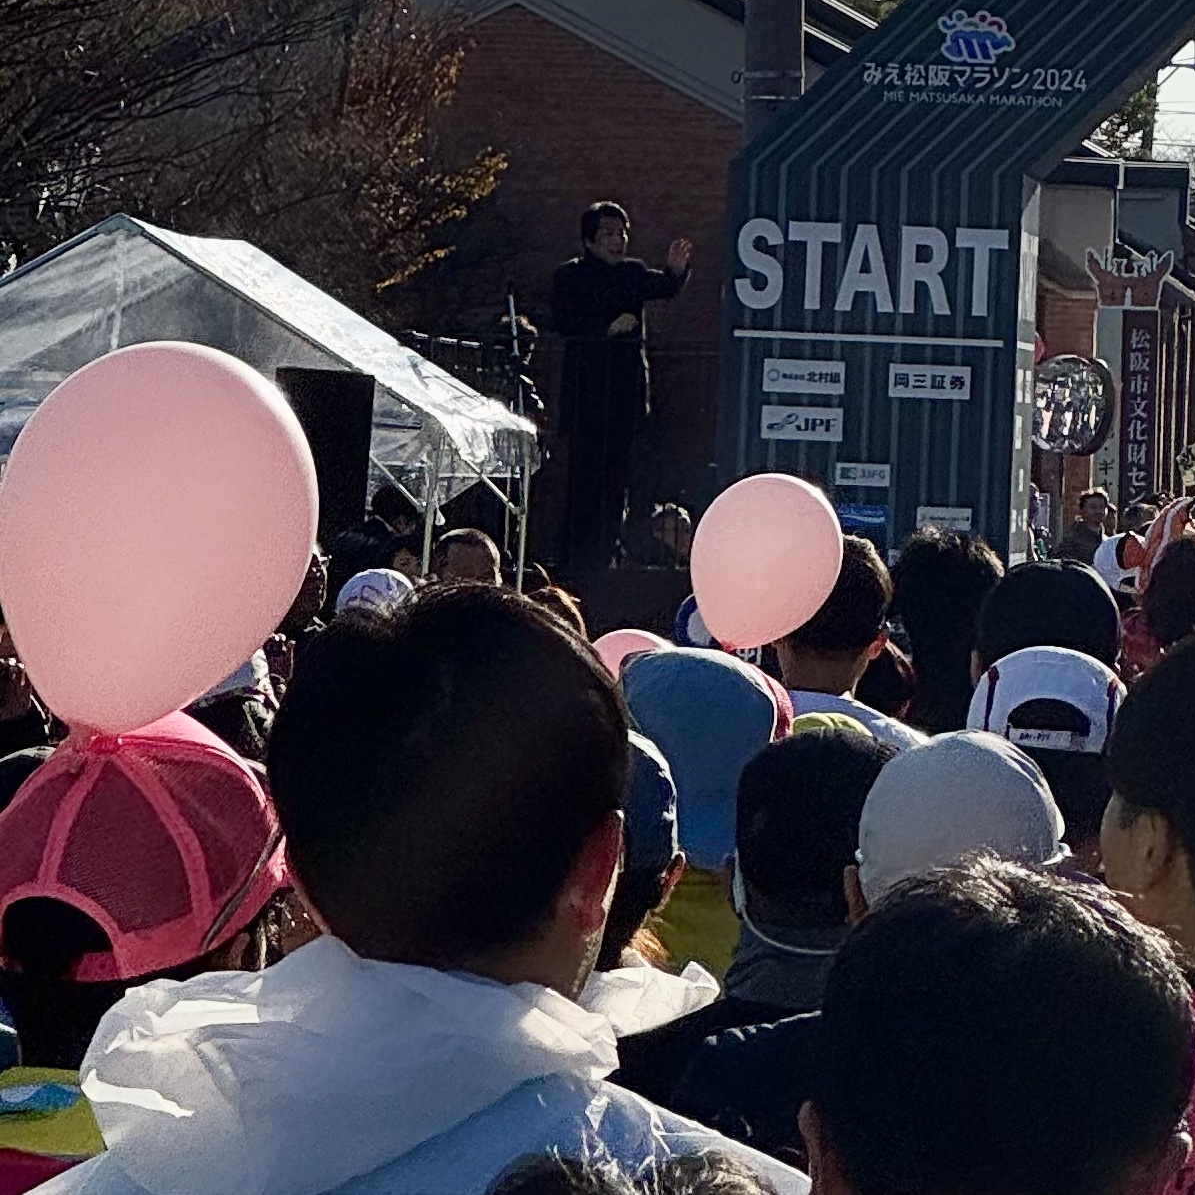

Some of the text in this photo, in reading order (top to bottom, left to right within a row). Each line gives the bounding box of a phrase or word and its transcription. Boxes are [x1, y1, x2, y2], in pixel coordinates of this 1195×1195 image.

[863, 62, 1088, 93] みえ松阪マラソン2024
[883, 90, 1063, 108] MIE MATSUSAKA MARATHON
[734, 217, 1009, 317] START
[796, 417, 838, 433] JPF
